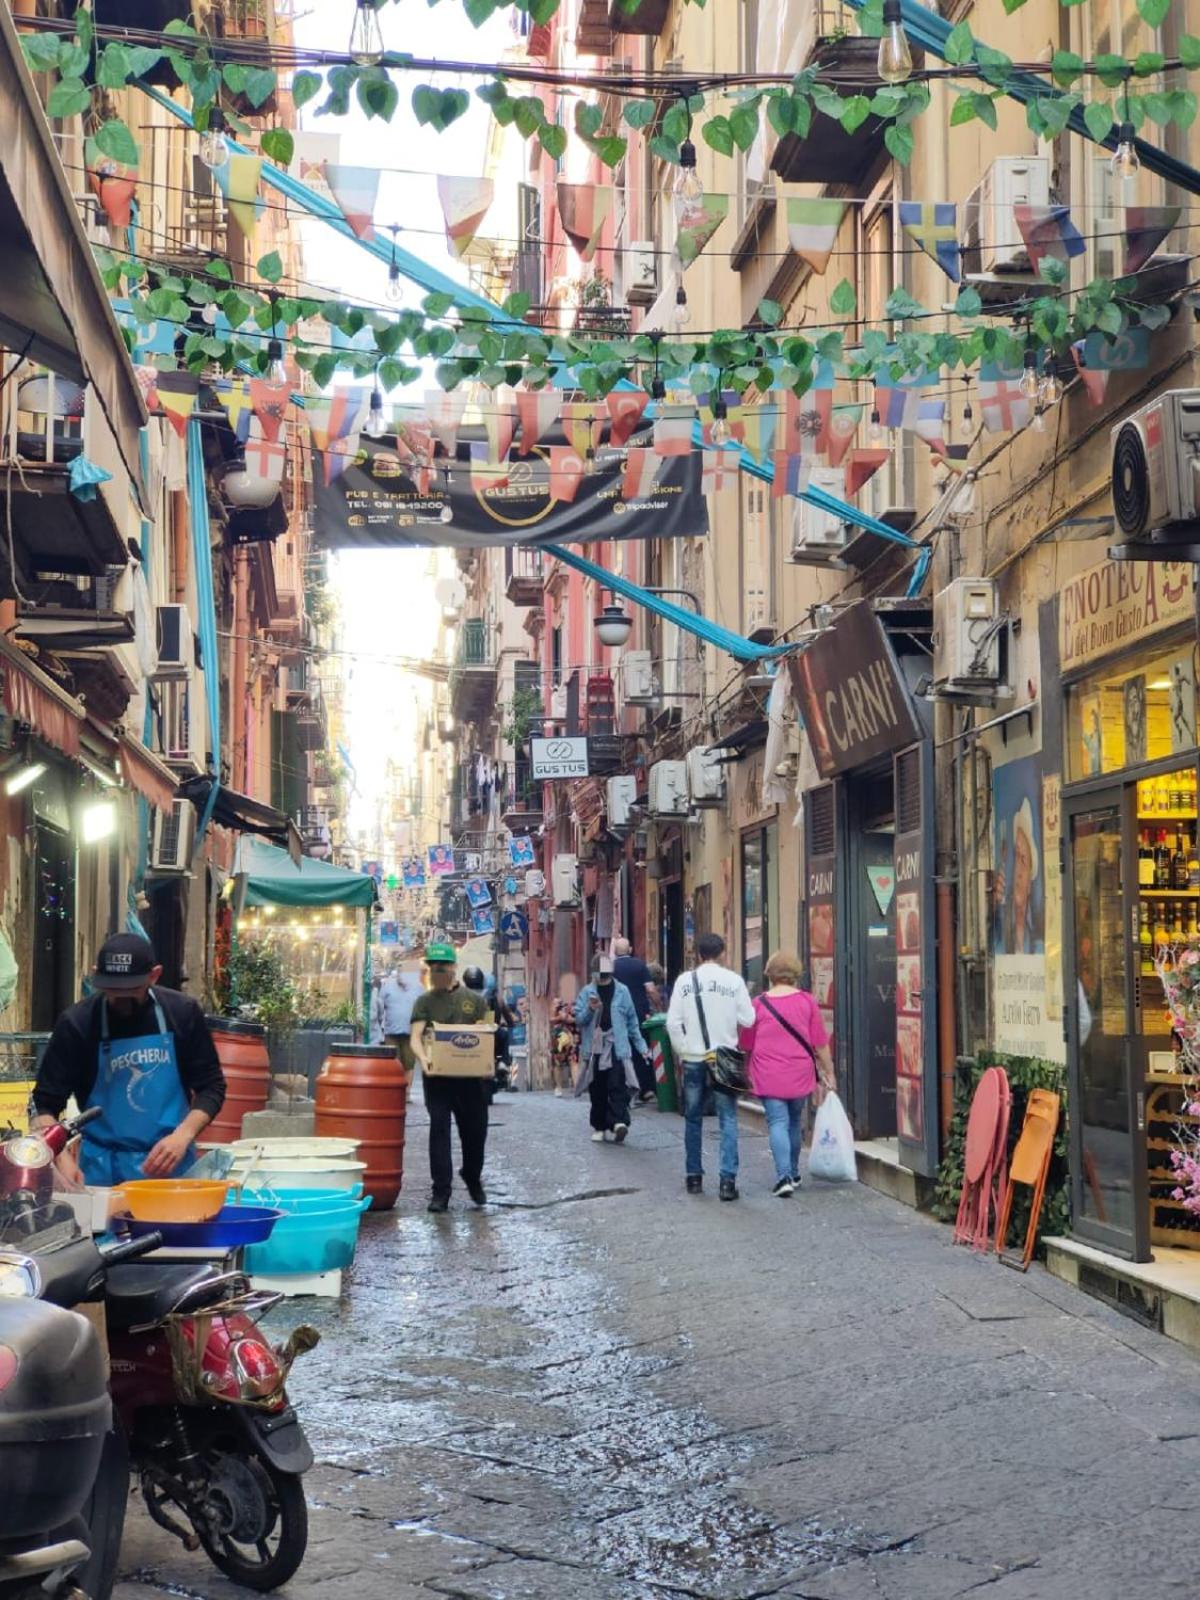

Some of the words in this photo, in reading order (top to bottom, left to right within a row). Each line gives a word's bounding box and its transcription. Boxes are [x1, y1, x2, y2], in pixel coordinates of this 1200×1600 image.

[485, 485, 549, 497] GUSTUS
[1075, 624, 1089, 656] del
[1090, 621, 1115, 650] Buon
[535, 764, 586, 774] GUSTUS
[896, 851, 920, 882] CARNI
[810, 871, 833, 897] CARNI
[110, 1048, 171, 1073] PESCHERIA
